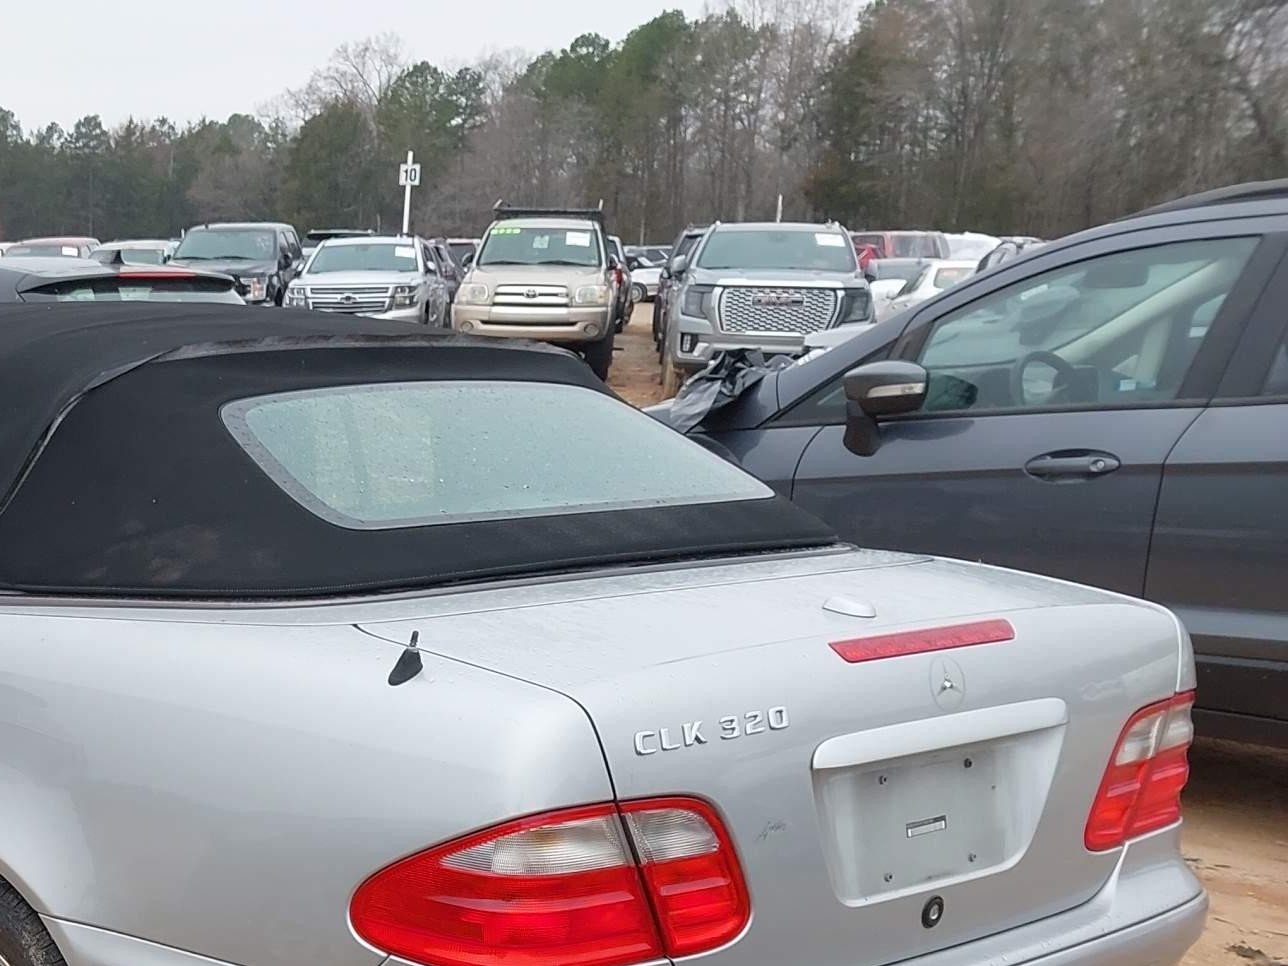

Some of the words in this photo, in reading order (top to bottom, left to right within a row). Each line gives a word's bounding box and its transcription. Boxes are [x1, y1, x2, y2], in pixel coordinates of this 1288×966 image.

[402, 168, 417, 182] 10
[634, 720, 708, 756] CLK
[719, 705, 790, 740] 320
